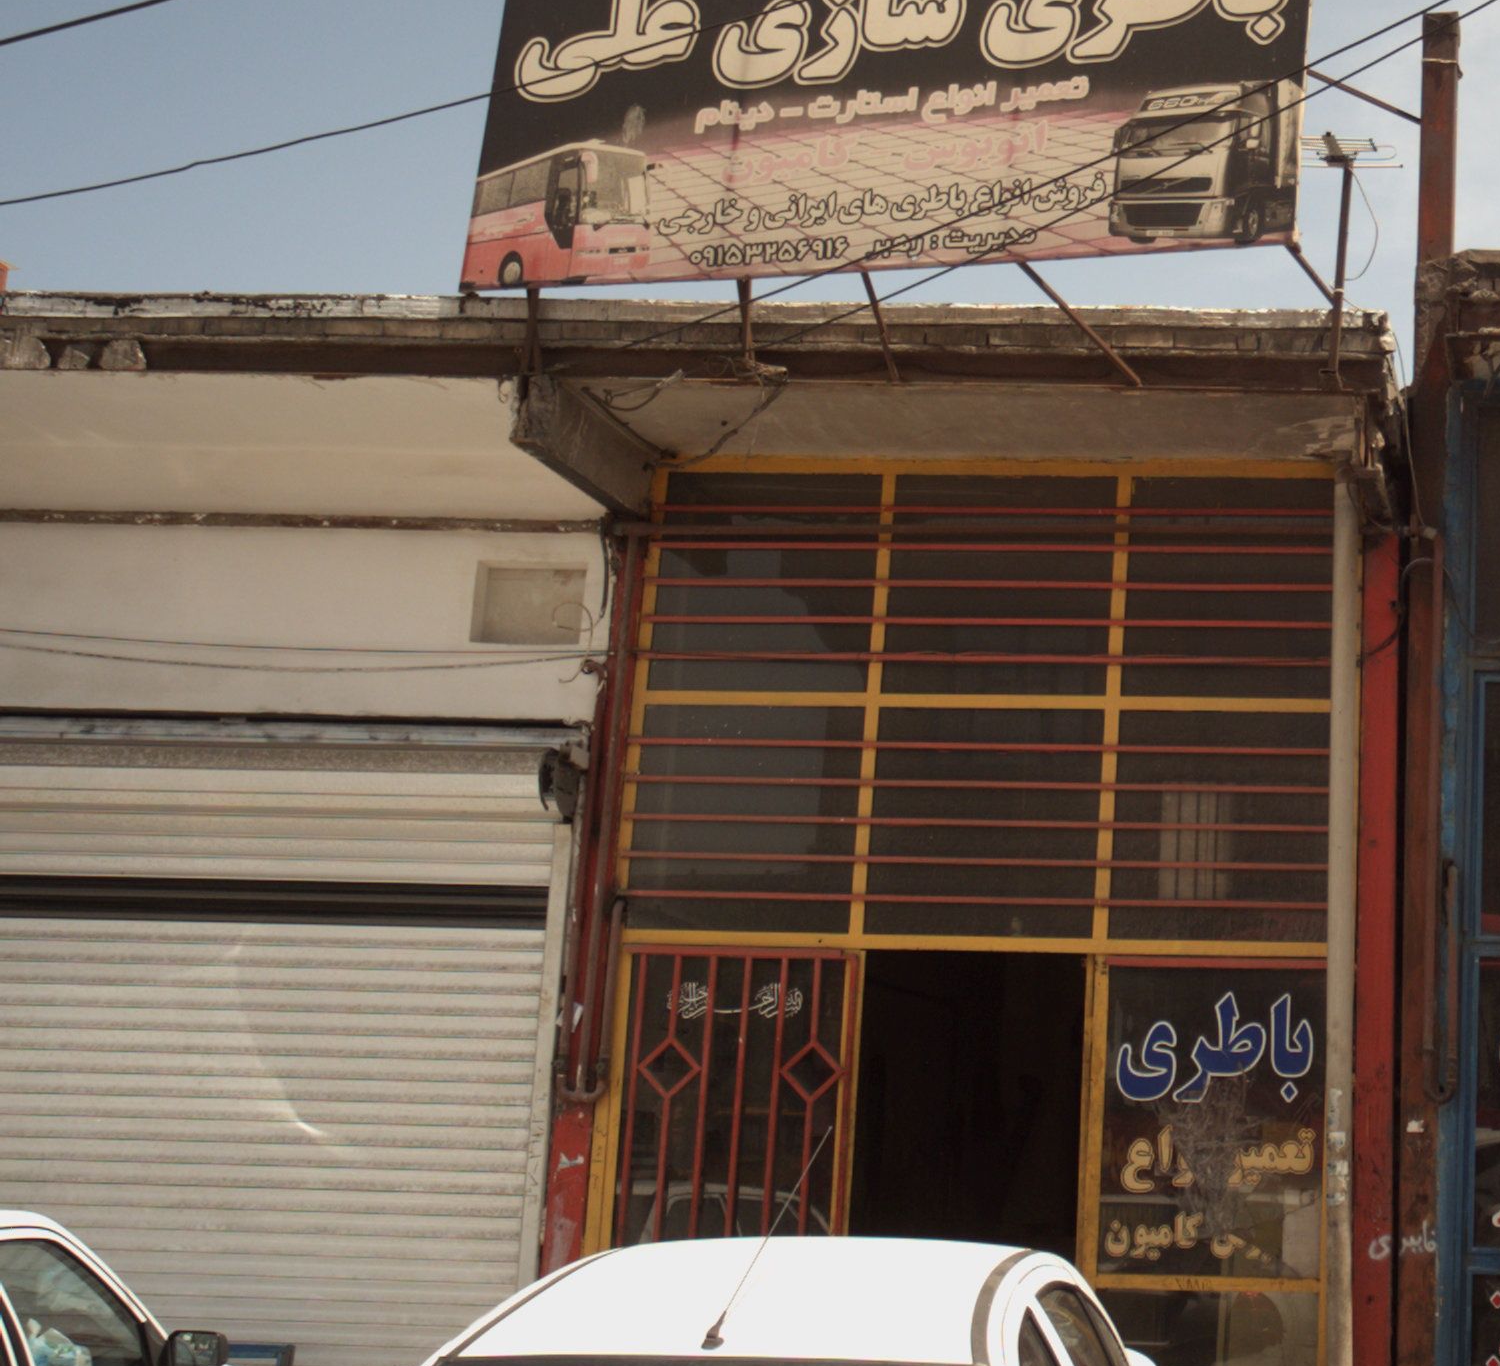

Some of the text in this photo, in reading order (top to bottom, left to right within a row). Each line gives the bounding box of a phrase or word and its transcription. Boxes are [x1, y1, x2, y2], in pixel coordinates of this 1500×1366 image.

[694, 99, 775, 134] دینام
[808, 86, 919, 124] استارت
[921, 81, 998, 123] انواع
[1000, 75, 1090, 112] تعمیر
[721, 137, 858, 184] کامیون
[903, 120, 1049, 171] اتوبوس
[658, 171, 1107, 236] فروش انواع باطری های ایرانی و خارجی
[943, 227, 1037, 254] مدیریت
[1116, 991, 1314, 1103] باطری
[1226, 1127, 1317, 1187] تعمیر
[1104, 1211, 1204, 1262] کامیون
